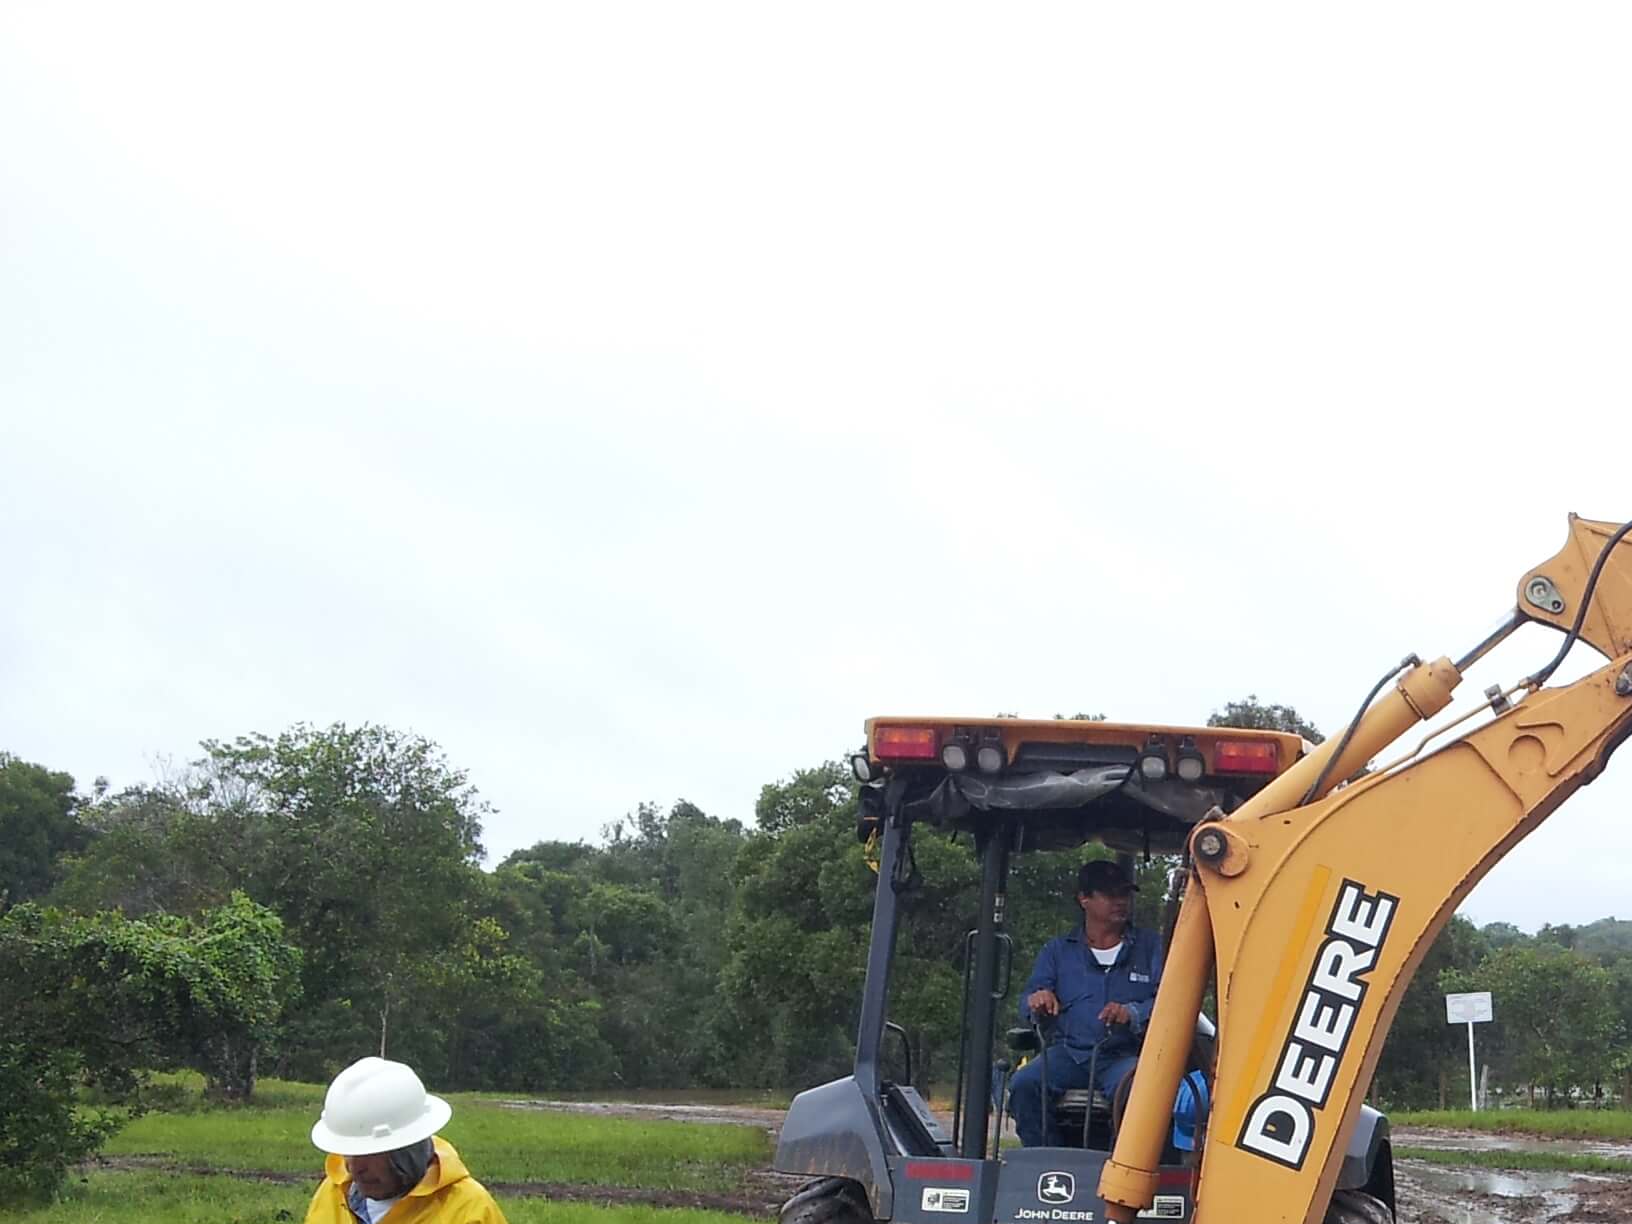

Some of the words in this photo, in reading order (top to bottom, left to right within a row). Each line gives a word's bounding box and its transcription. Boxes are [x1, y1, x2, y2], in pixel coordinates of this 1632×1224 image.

[1239, 882, 1396, 1168] DEERE
[1014, 1207, 1050, 1220] JOHN
[1051, 1209, 1094, 1221] DEERE
